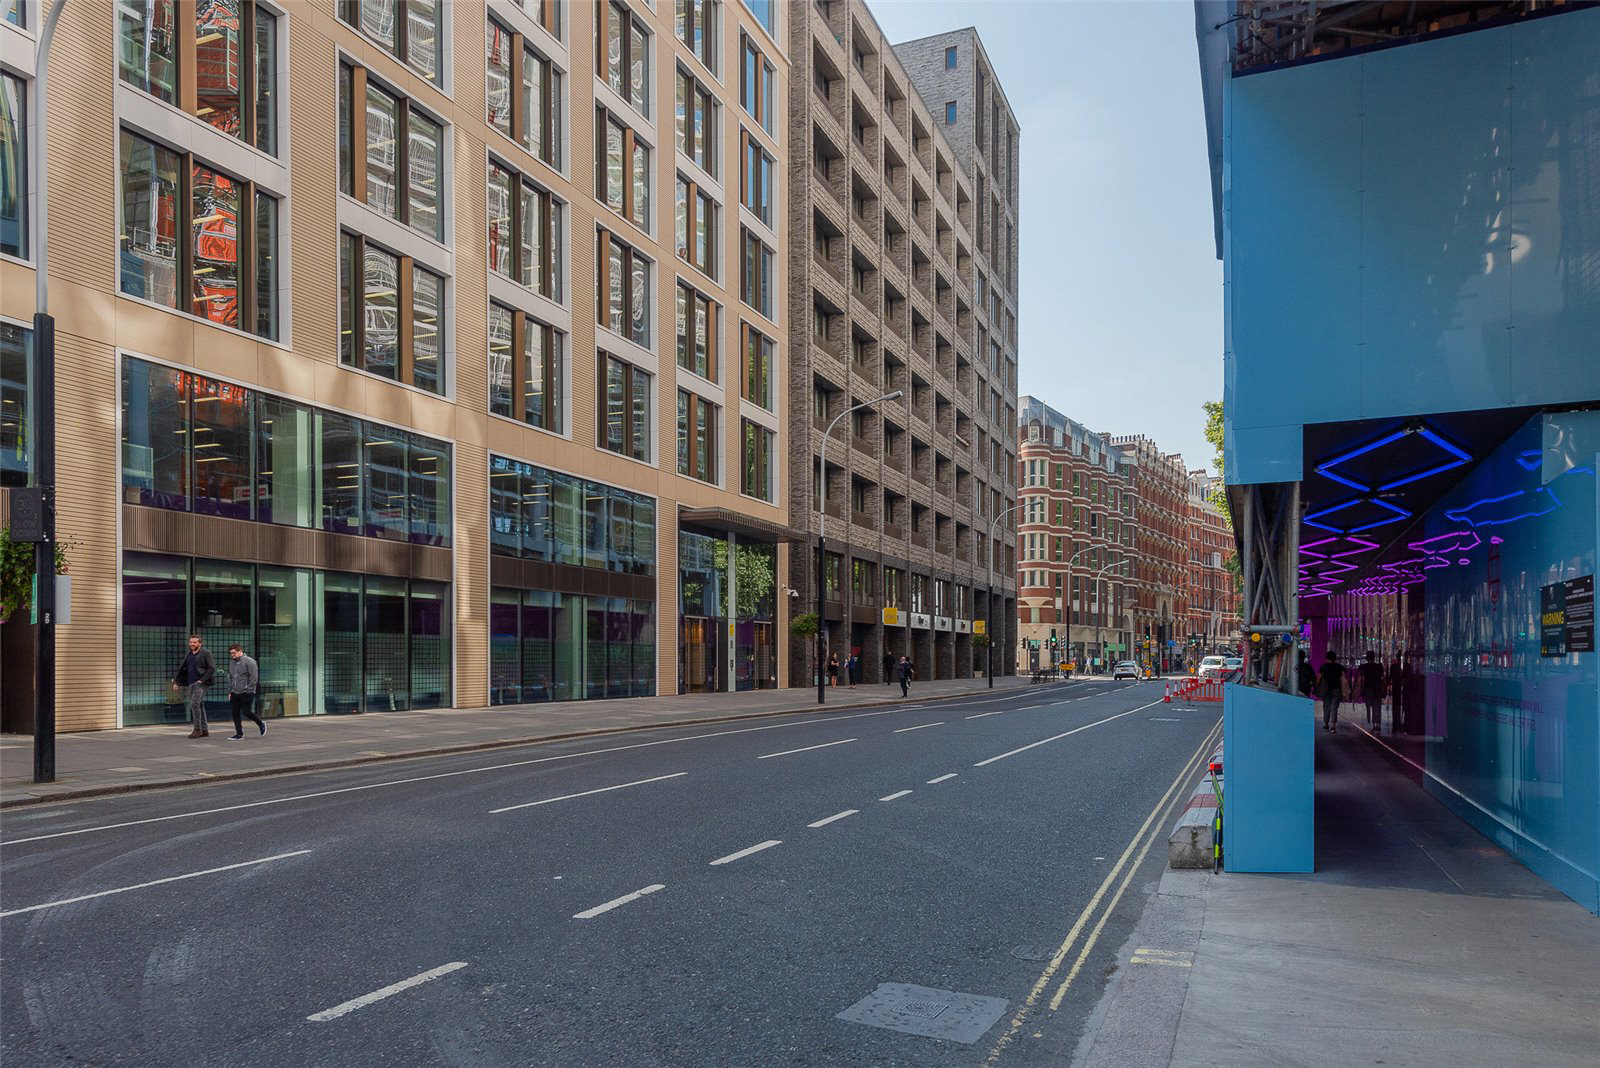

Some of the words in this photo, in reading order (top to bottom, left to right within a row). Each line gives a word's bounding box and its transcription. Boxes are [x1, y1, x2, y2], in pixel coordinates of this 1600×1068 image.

[17, 499, 31, 511] 20
[15, 520, 37, 528] SLOW
[14, 529, 38, 538] DOWN
[1542, 611, 1564, 625] WARNING
